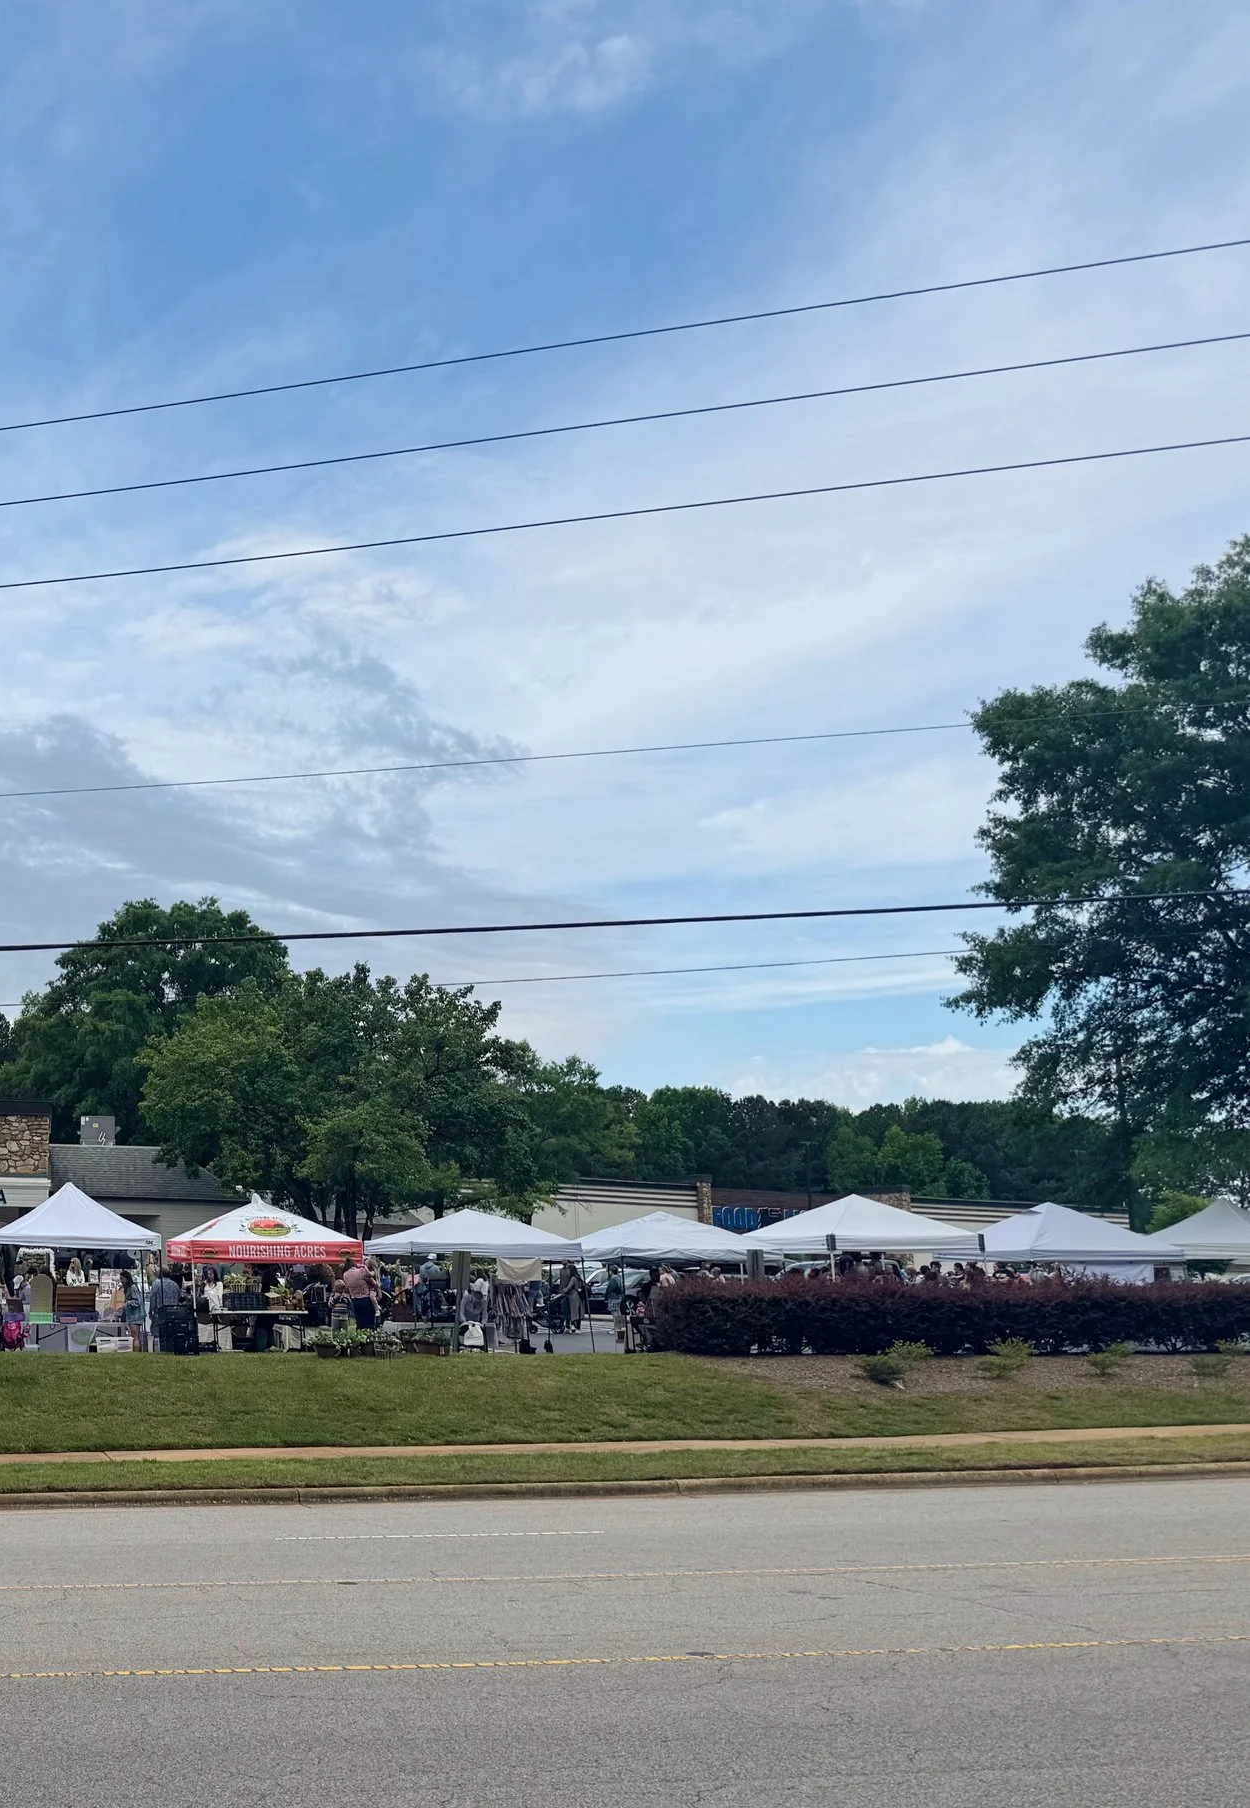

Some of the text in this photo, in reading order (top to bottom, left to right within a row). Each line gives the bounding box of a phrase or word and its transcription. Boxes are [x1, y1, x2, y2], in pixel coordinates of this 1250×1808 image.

[711, 1206, 758, 1228] FOOD
[229, 1245, 326, 1258] NOURISHING ACRES
